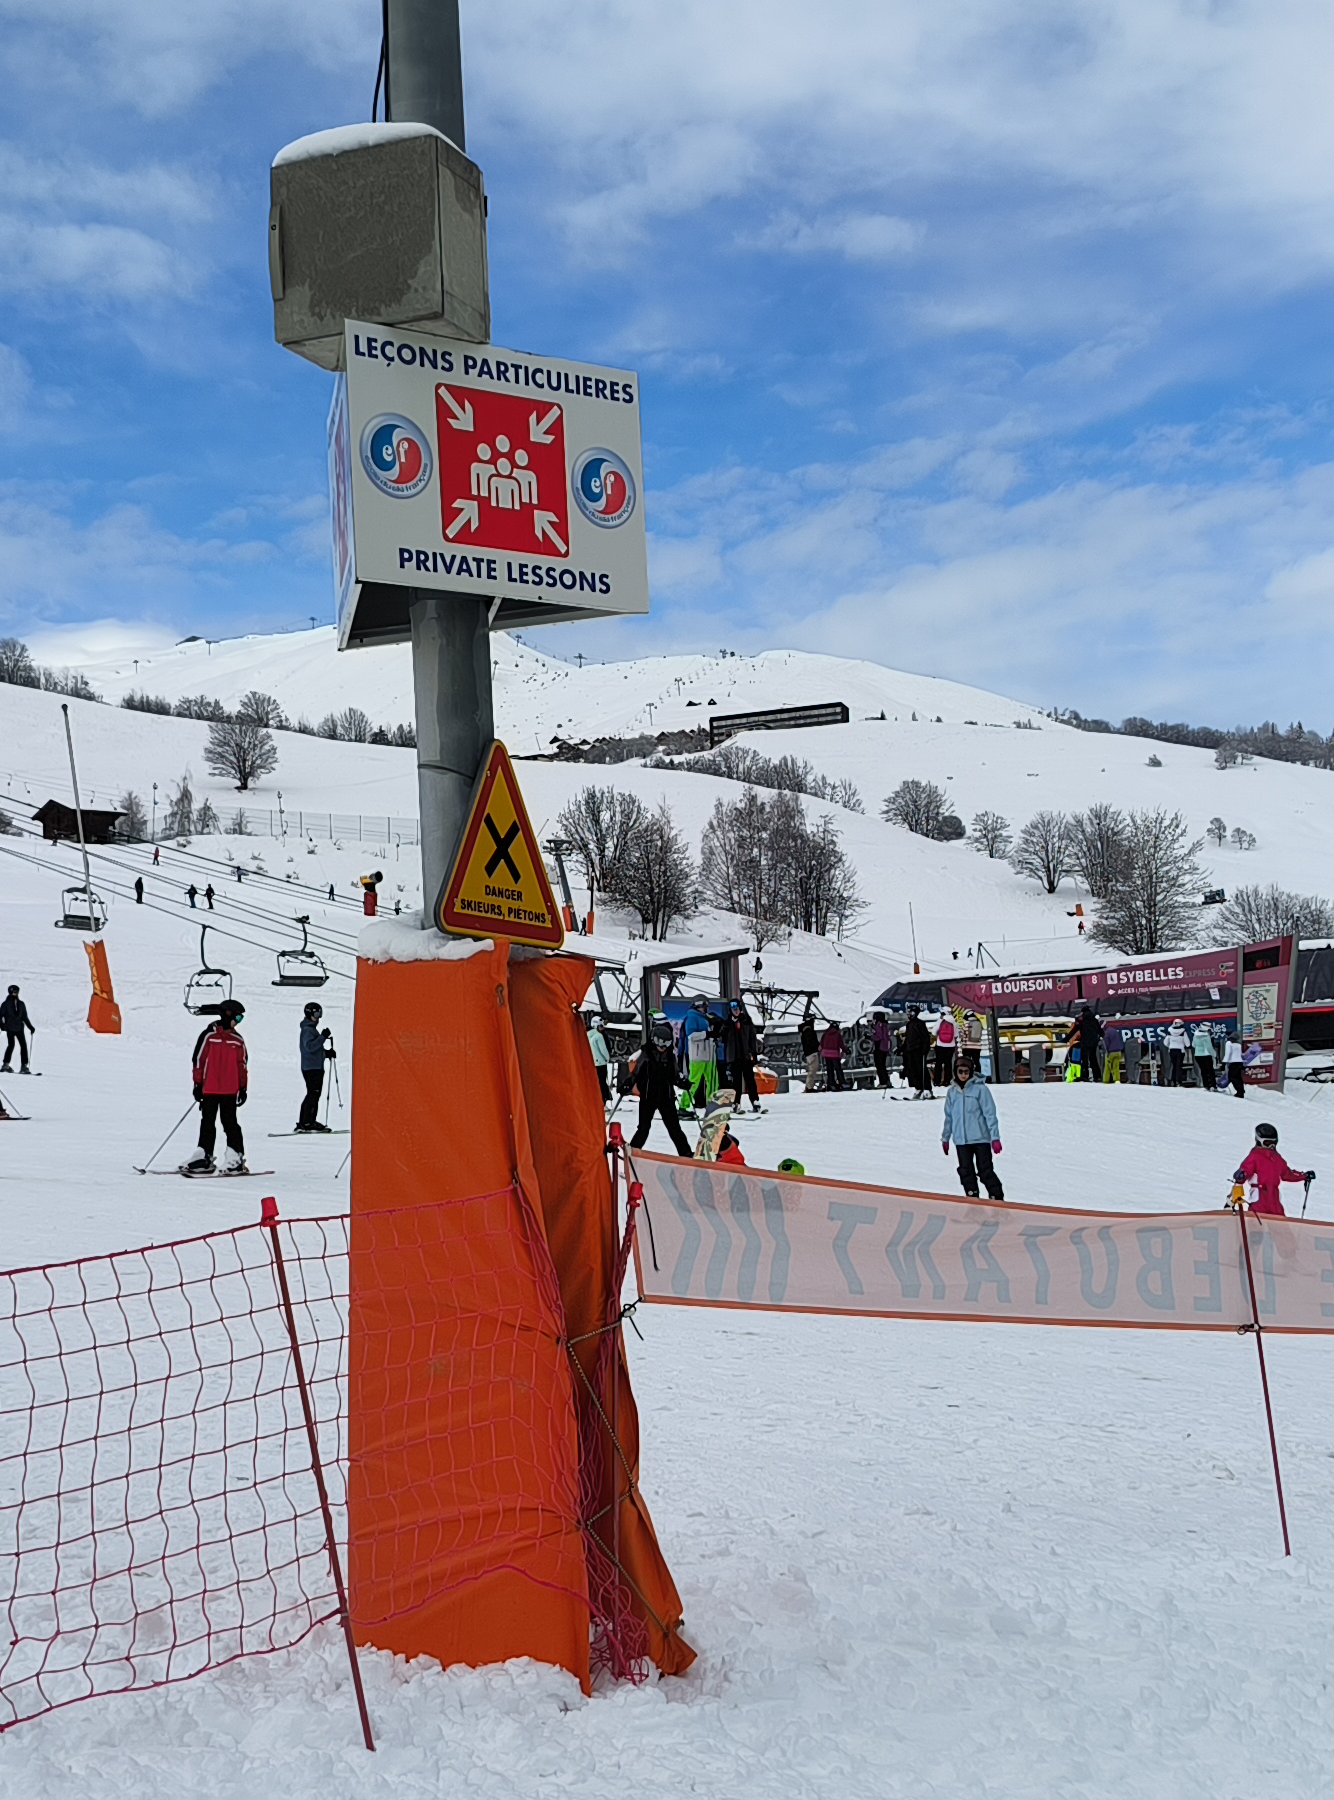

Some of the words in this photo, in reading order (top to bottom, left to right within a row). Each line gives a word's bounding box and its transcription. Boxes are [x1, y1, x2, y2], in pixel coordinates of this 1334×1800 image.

[354, 334, 455, 372] LEÇONS
[463, 354, 635, 404] PARTICULIERES
[398, 547, 498, 580] PRIVATE
[506, 561, 611, 594] LESSONS
[484, 884, 523, 902] DANGER
[460, 898, 505, 919] SKIEURS,
[507, 905, 546, 924] PIÉTONS
[980, 984, 987, 994] 7
[1003, 978, 1053, 994] OURSON
[1091, 974, 1098, 984] 8
[1119, 966, 1184, 984] SYBELLES
[1184, 967, 1216, 979] EXPRESS
